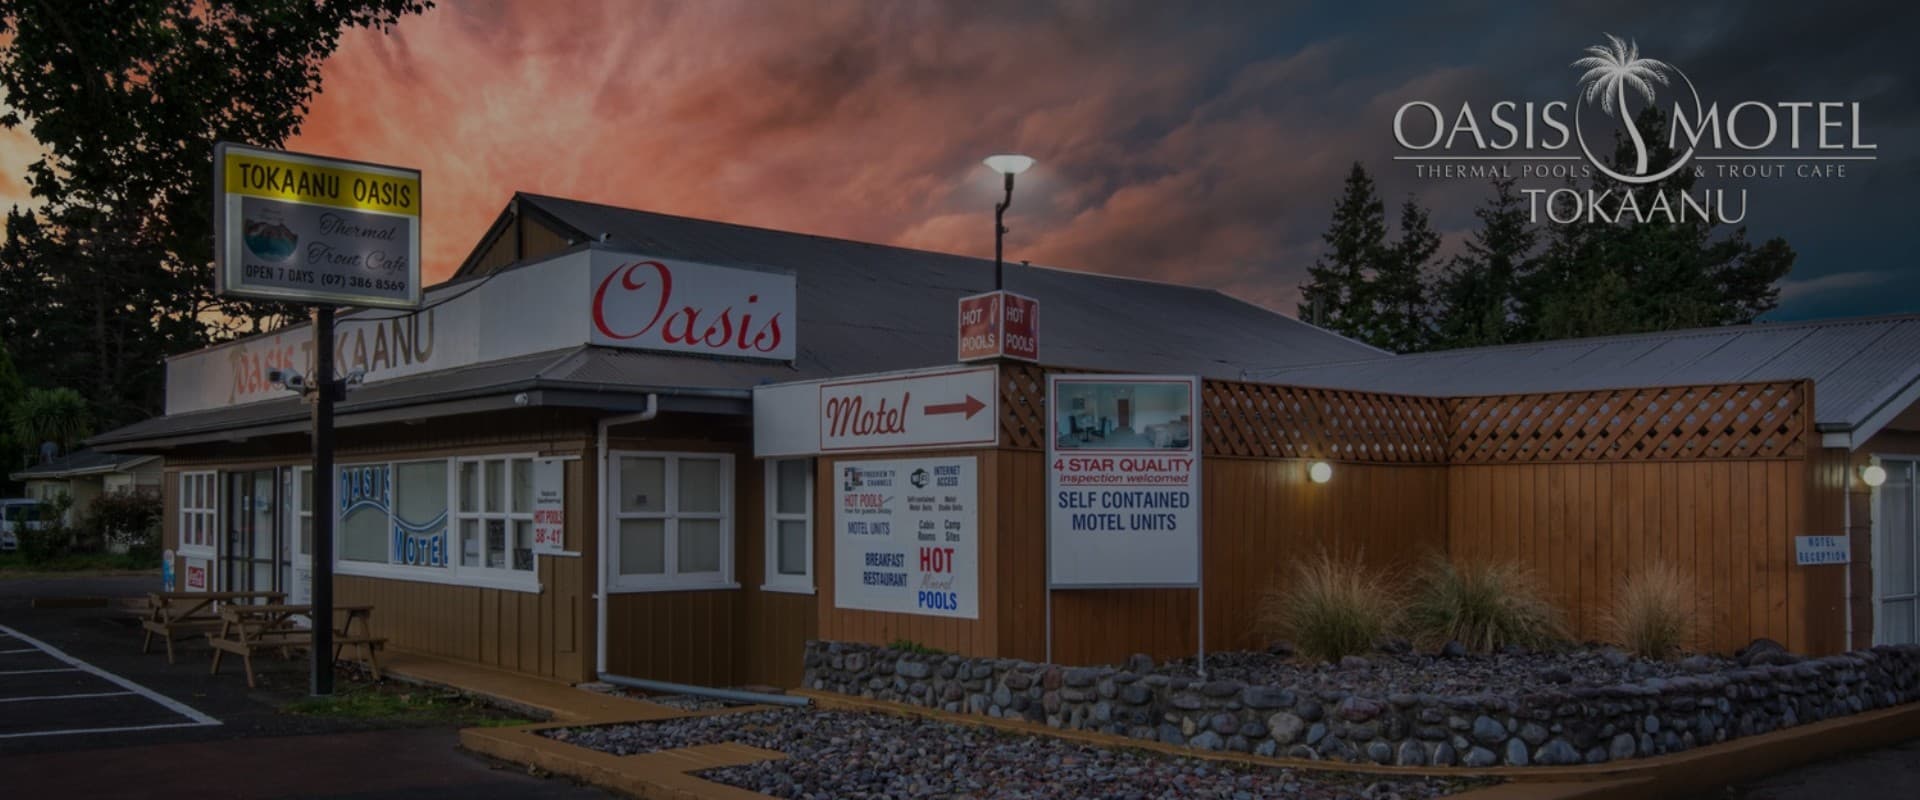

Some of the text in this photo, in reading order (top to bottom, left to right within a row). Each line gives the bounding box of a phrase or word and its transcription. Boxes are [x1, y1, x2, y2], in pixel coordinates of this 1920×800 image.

[239, 163, 411, 209] TOKAANU OASIS
[319, 212, 397, 242] Thermal
[307, 241, 360, 266] Trout
[246, 264, 405, 292] OPEN 7 DAYS (07) 386 8569
[592, 260, 783, 353] Oasis
[1006, 306, 1025, 324] HOT
[962, 308, 984, 326] HOT
[301, 308, 435, 381] TKAANU
[961, 333, 995, 353] POOLS
[1005, 334, 1034, 353] POOLS
[826, 391, 911, 438] Motel
[934, 465, 961, 477] INTERNET
[1053, 458, 1194, 473] 4 STAR QUALITY
[936, 476, 959, 487] ACCESS
[1059, 473, 1189, 485] inspection welcomed
[340, 465, 390, 512] OASIS
[844, 493, 883, 507] HOT POOLS
[1058, 491, 1190, 509] SELF CONTAINED
[535, 510, 545, 525] HOT
[918, 519, 935, 530] Cabin
[944, 519, 961, 531] Camp
[1072, 513, 1177, 531] MOTEL UNITS
[847, 521, 890, 535] MOTEL UNITS
[917, 531, 936, 542] Rooms
[945, 531, 960, 542] Sites
[394, 524, 449, 567] MOTEL
[1808, 537, 1836, 547] MOTEL
[865, 552, 905, 568] BREAKFAST
[919, 547, 955, 573] HOT
[1799, 551, 1847, 563] RECEPTION
[863, 571, 908, 588] RESTAURANT
[918, 591, 958, 611] POOLS
